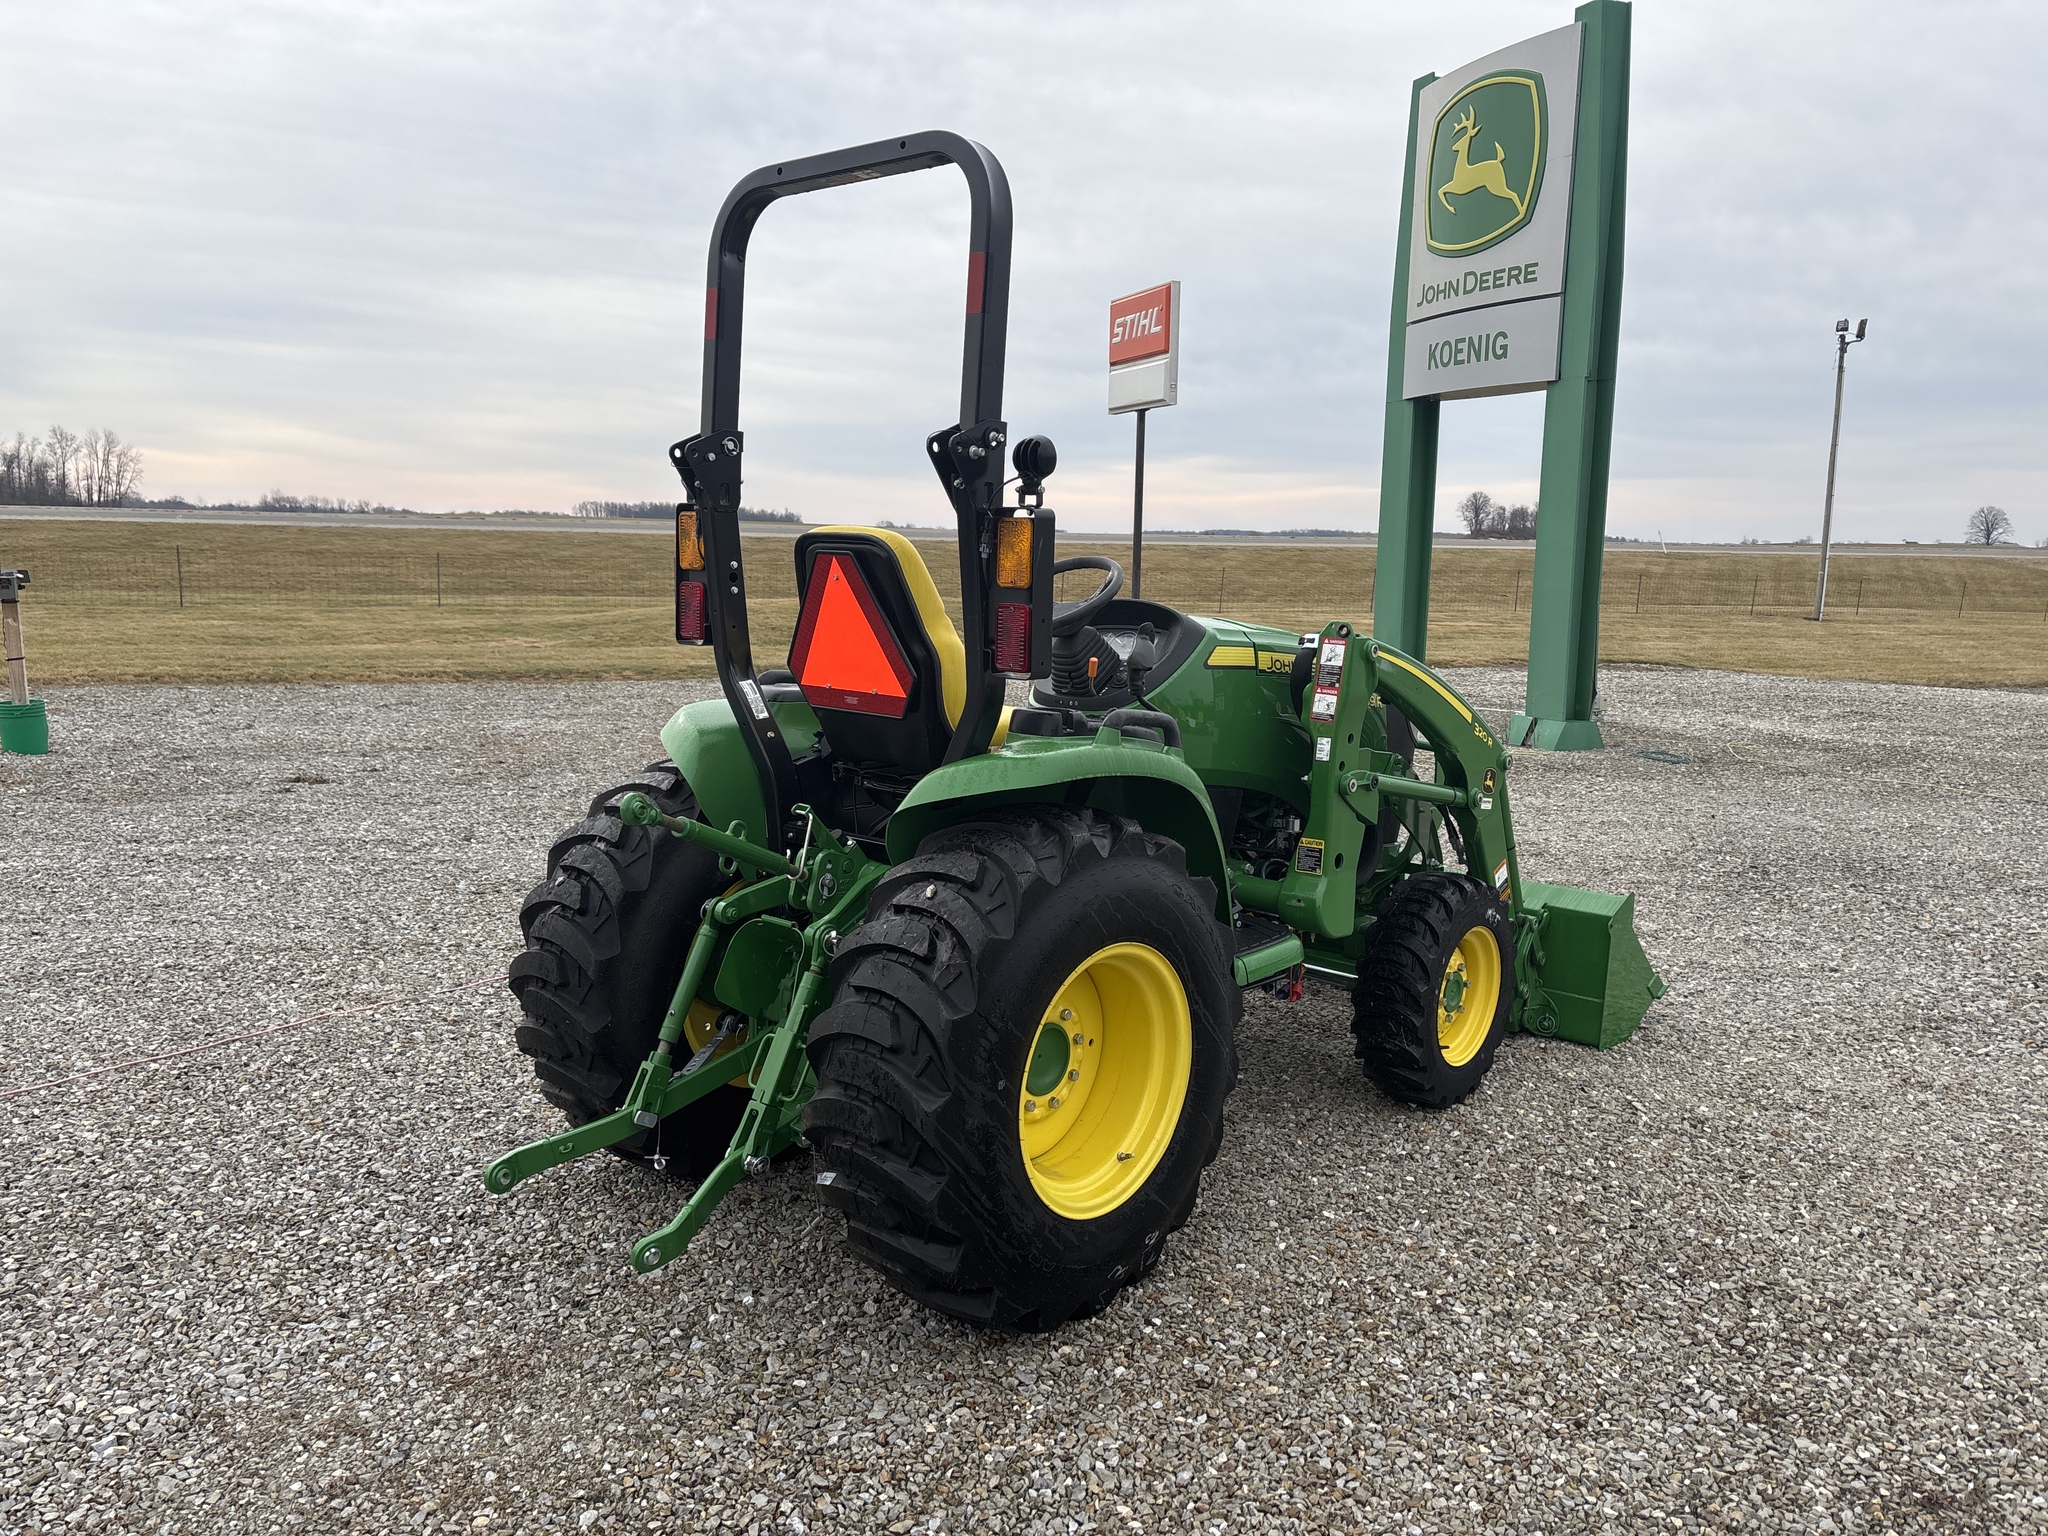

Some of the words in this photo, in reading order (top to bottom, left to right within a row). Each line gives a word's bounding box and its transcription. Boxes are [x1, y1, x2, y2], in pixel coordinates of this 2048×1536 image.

[1417, 277, 1460, 308] JOHN
[1462, 262, 1539, 296] DEERE
[1111, 306, 1163, 345] STIHL
[1427, 330, 1509, 371] KOENIG
[1266, 656, 1294, 673] JOH
[1304, 839, 1324, 847] CAUTION
